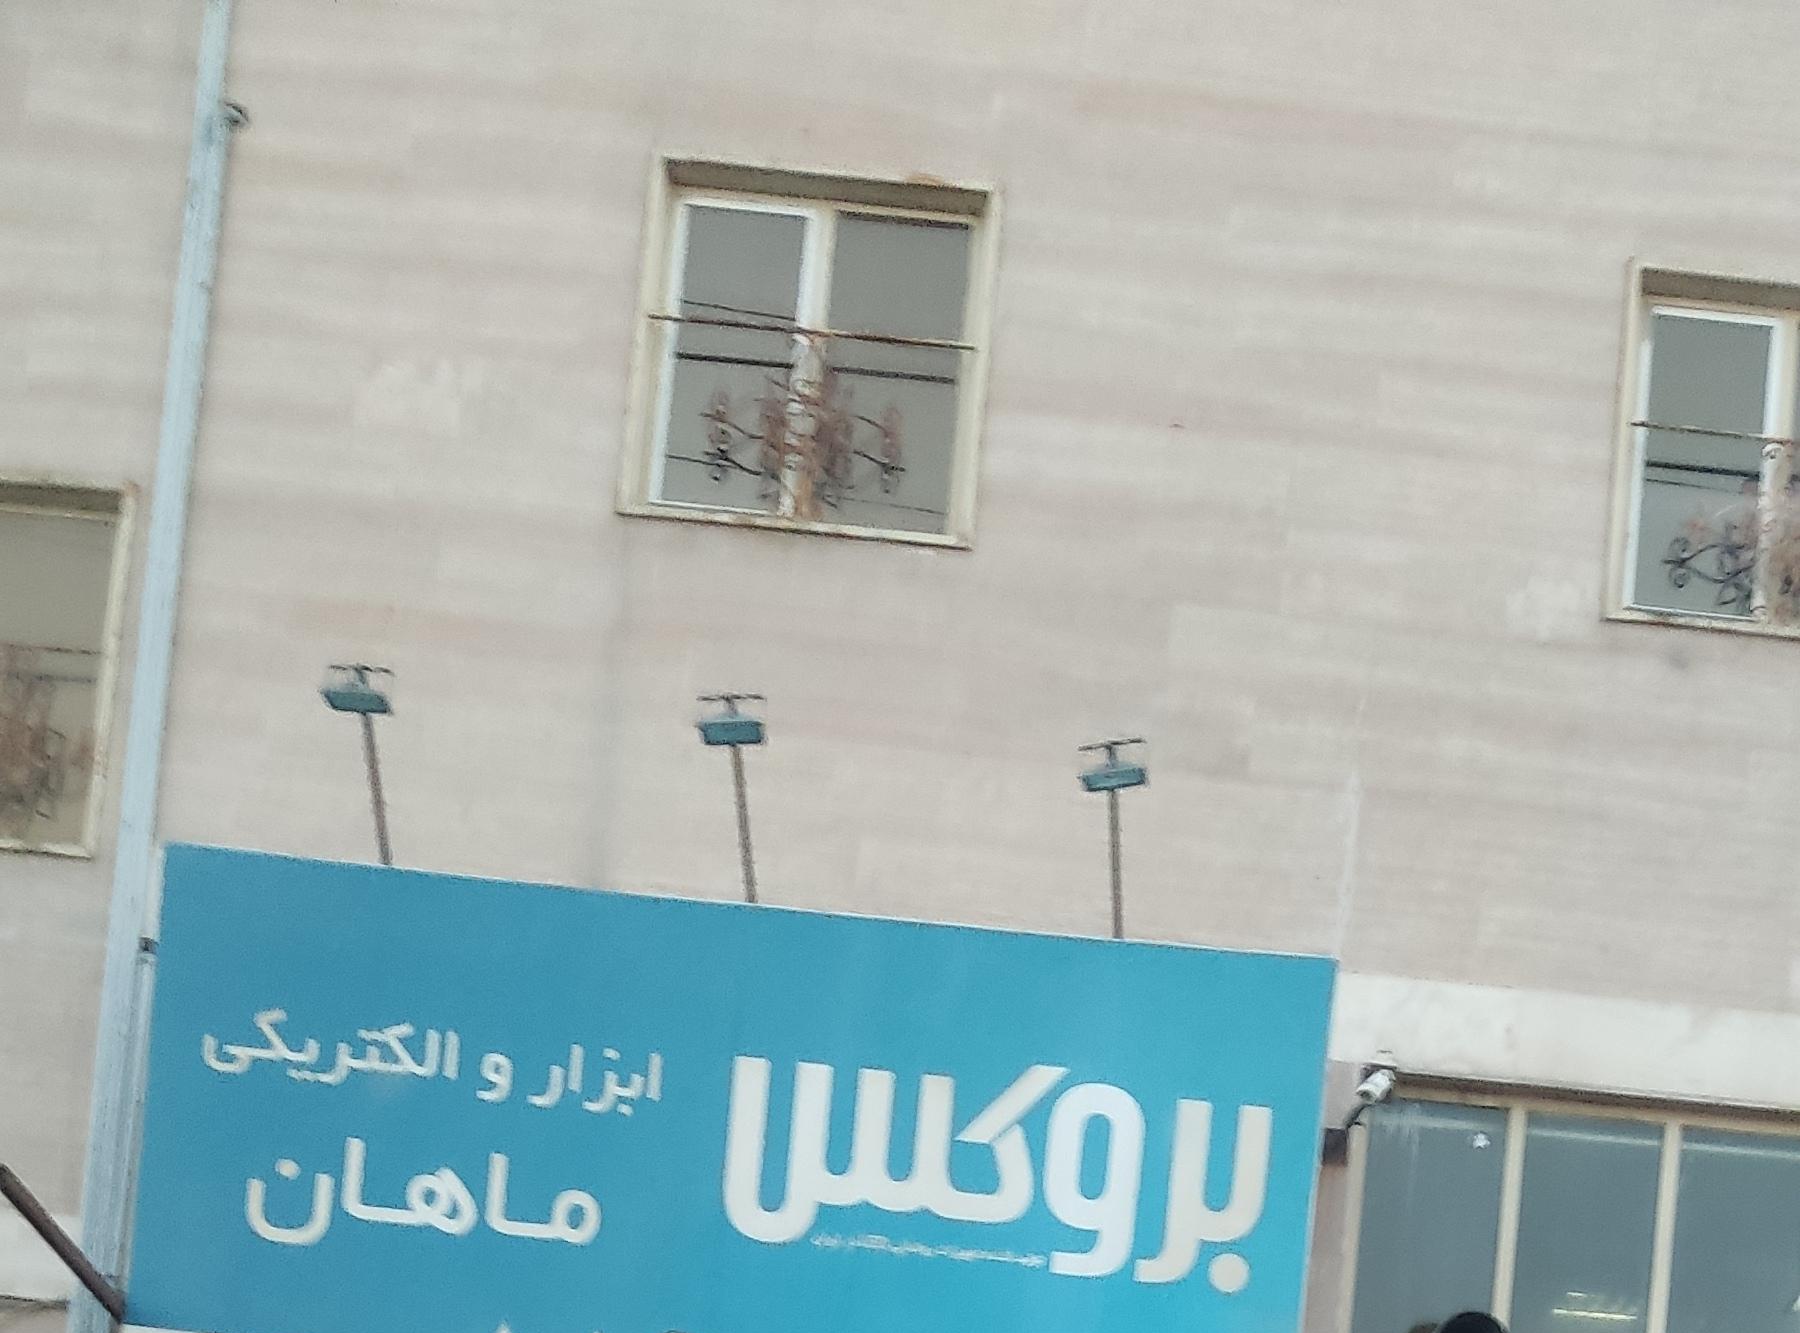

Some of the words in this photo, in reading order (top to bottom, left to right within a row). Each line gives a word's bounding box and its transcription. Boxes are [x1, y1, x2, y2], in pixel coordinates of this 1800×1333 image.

[202, 1007, 461, 1086] الکتریکی
[476, 1052, 513, 1103] و
[527, 1044, 663, 1116] ابزار
[244, 1136, 602, 1246] ماهان
[722, 1055, 1273, 1294] بروکس
